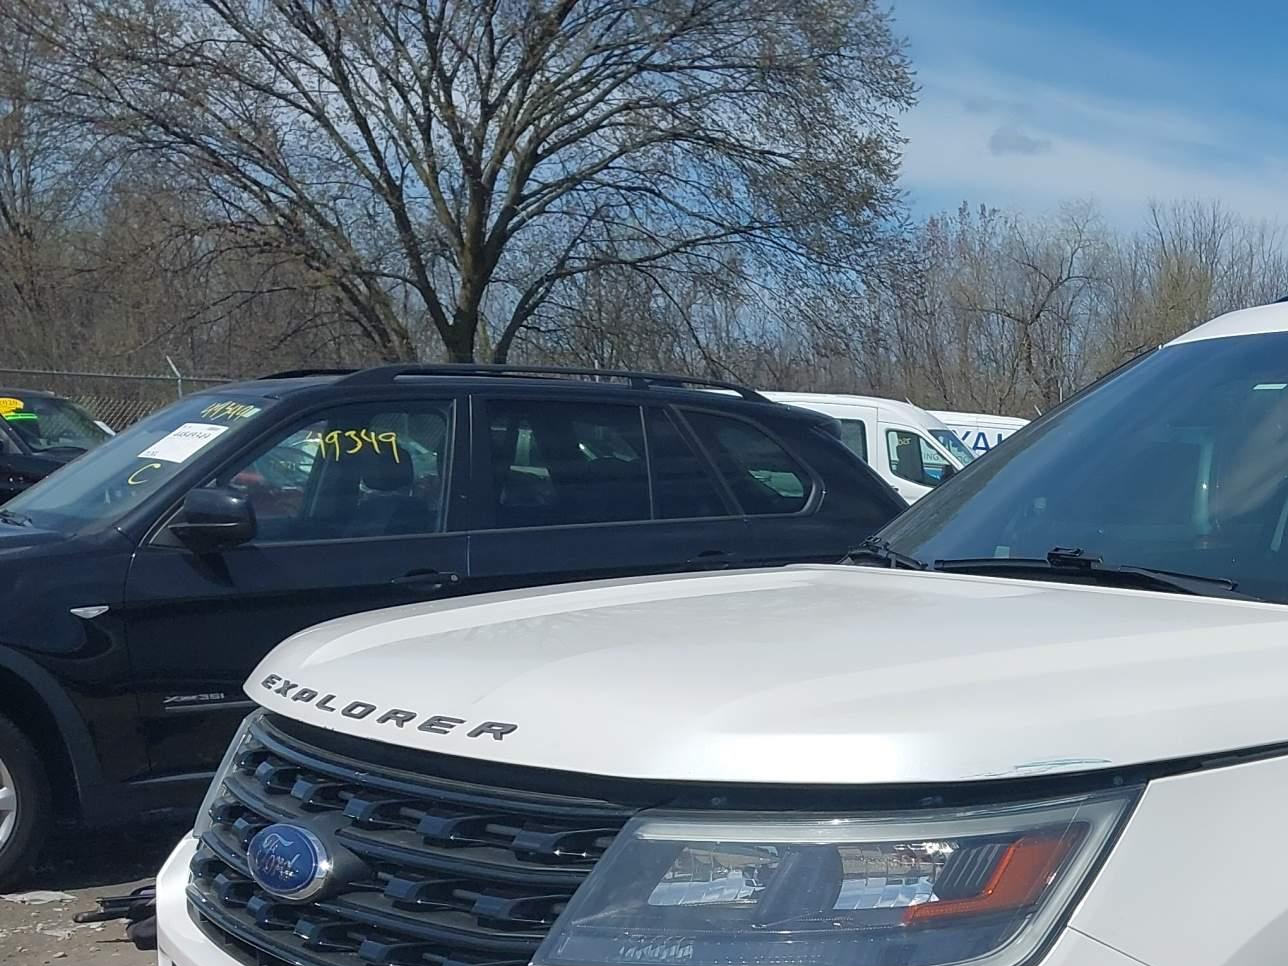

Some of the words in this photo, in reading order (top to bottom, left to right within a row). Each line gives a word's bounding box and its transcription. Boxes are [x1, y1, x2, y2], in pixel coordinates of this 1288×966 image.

[306, 429, 400, 463] 49349
[128, 463, 161, 485] C
[260, 673, 519, 741] EXPLORER
